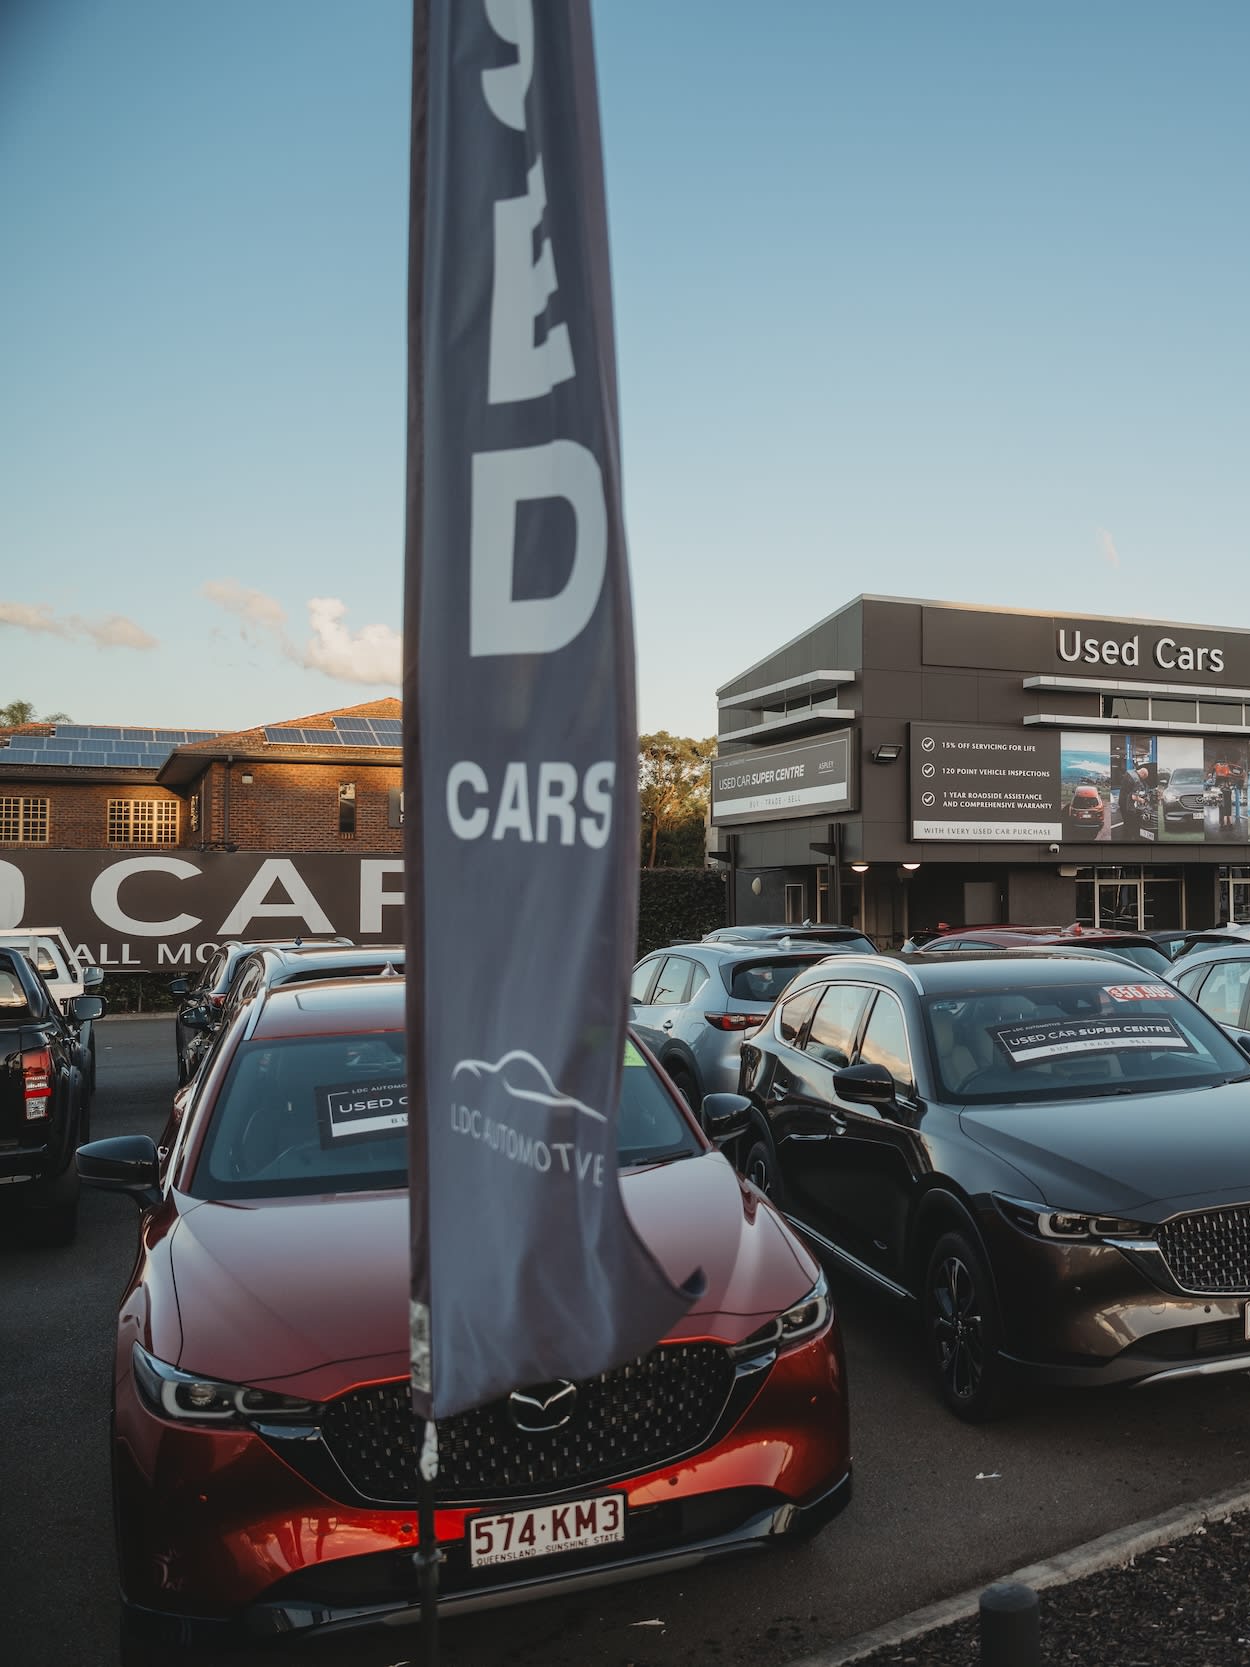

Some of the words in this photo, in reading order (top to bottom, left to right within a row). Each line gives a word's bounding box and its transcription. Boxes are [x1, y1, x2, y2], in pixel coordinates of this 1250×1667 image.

[1059, 629, 1139, 666] Used
[1156, 638, 1225, 672] Cars
[972, 743, 1007, 751] SERVICING
[719, 776, 736, 791] USED
[736, 774, 752, 787] CAR
[751, 770, 775, 785] SUPER
[775, 765, 805, 781] CENTRE
[942, 767, 955, 775] 120
[979, 768, 1007, 776] VEHICLE
[1008, 769, 1050, 778] INSPECTIONS
[445, 760, 616, 848] CARS
[968, 792, 1002, 800] ROADSIDE
[1003, 793, 1042, 801] ASSISTANCE
[960, 801, 1015, 809] COMPREHENSIVE
[947, 827, 970, 835] EVERY
[1012, 828, 1051, 836] PURCHASE
[1110, 985, 1176, 999] $56,995
[1010, 1033, 1046, 1046] USED
[1048, 1030, 1078, 1039] CAR
[1079, 1026, 1122, 1036] SUPER
[1124, 1025, 1172, 1033] CENTRE
[339, 1098, 393, 1113] USED
[450, 1103, 482, 1139] LDC
[476, 1548, 537, 1566] QUEENSLAND
[545, 1538, 589, 1553] SUNSHINE
[593, 1533, 620, 1544] STATE
